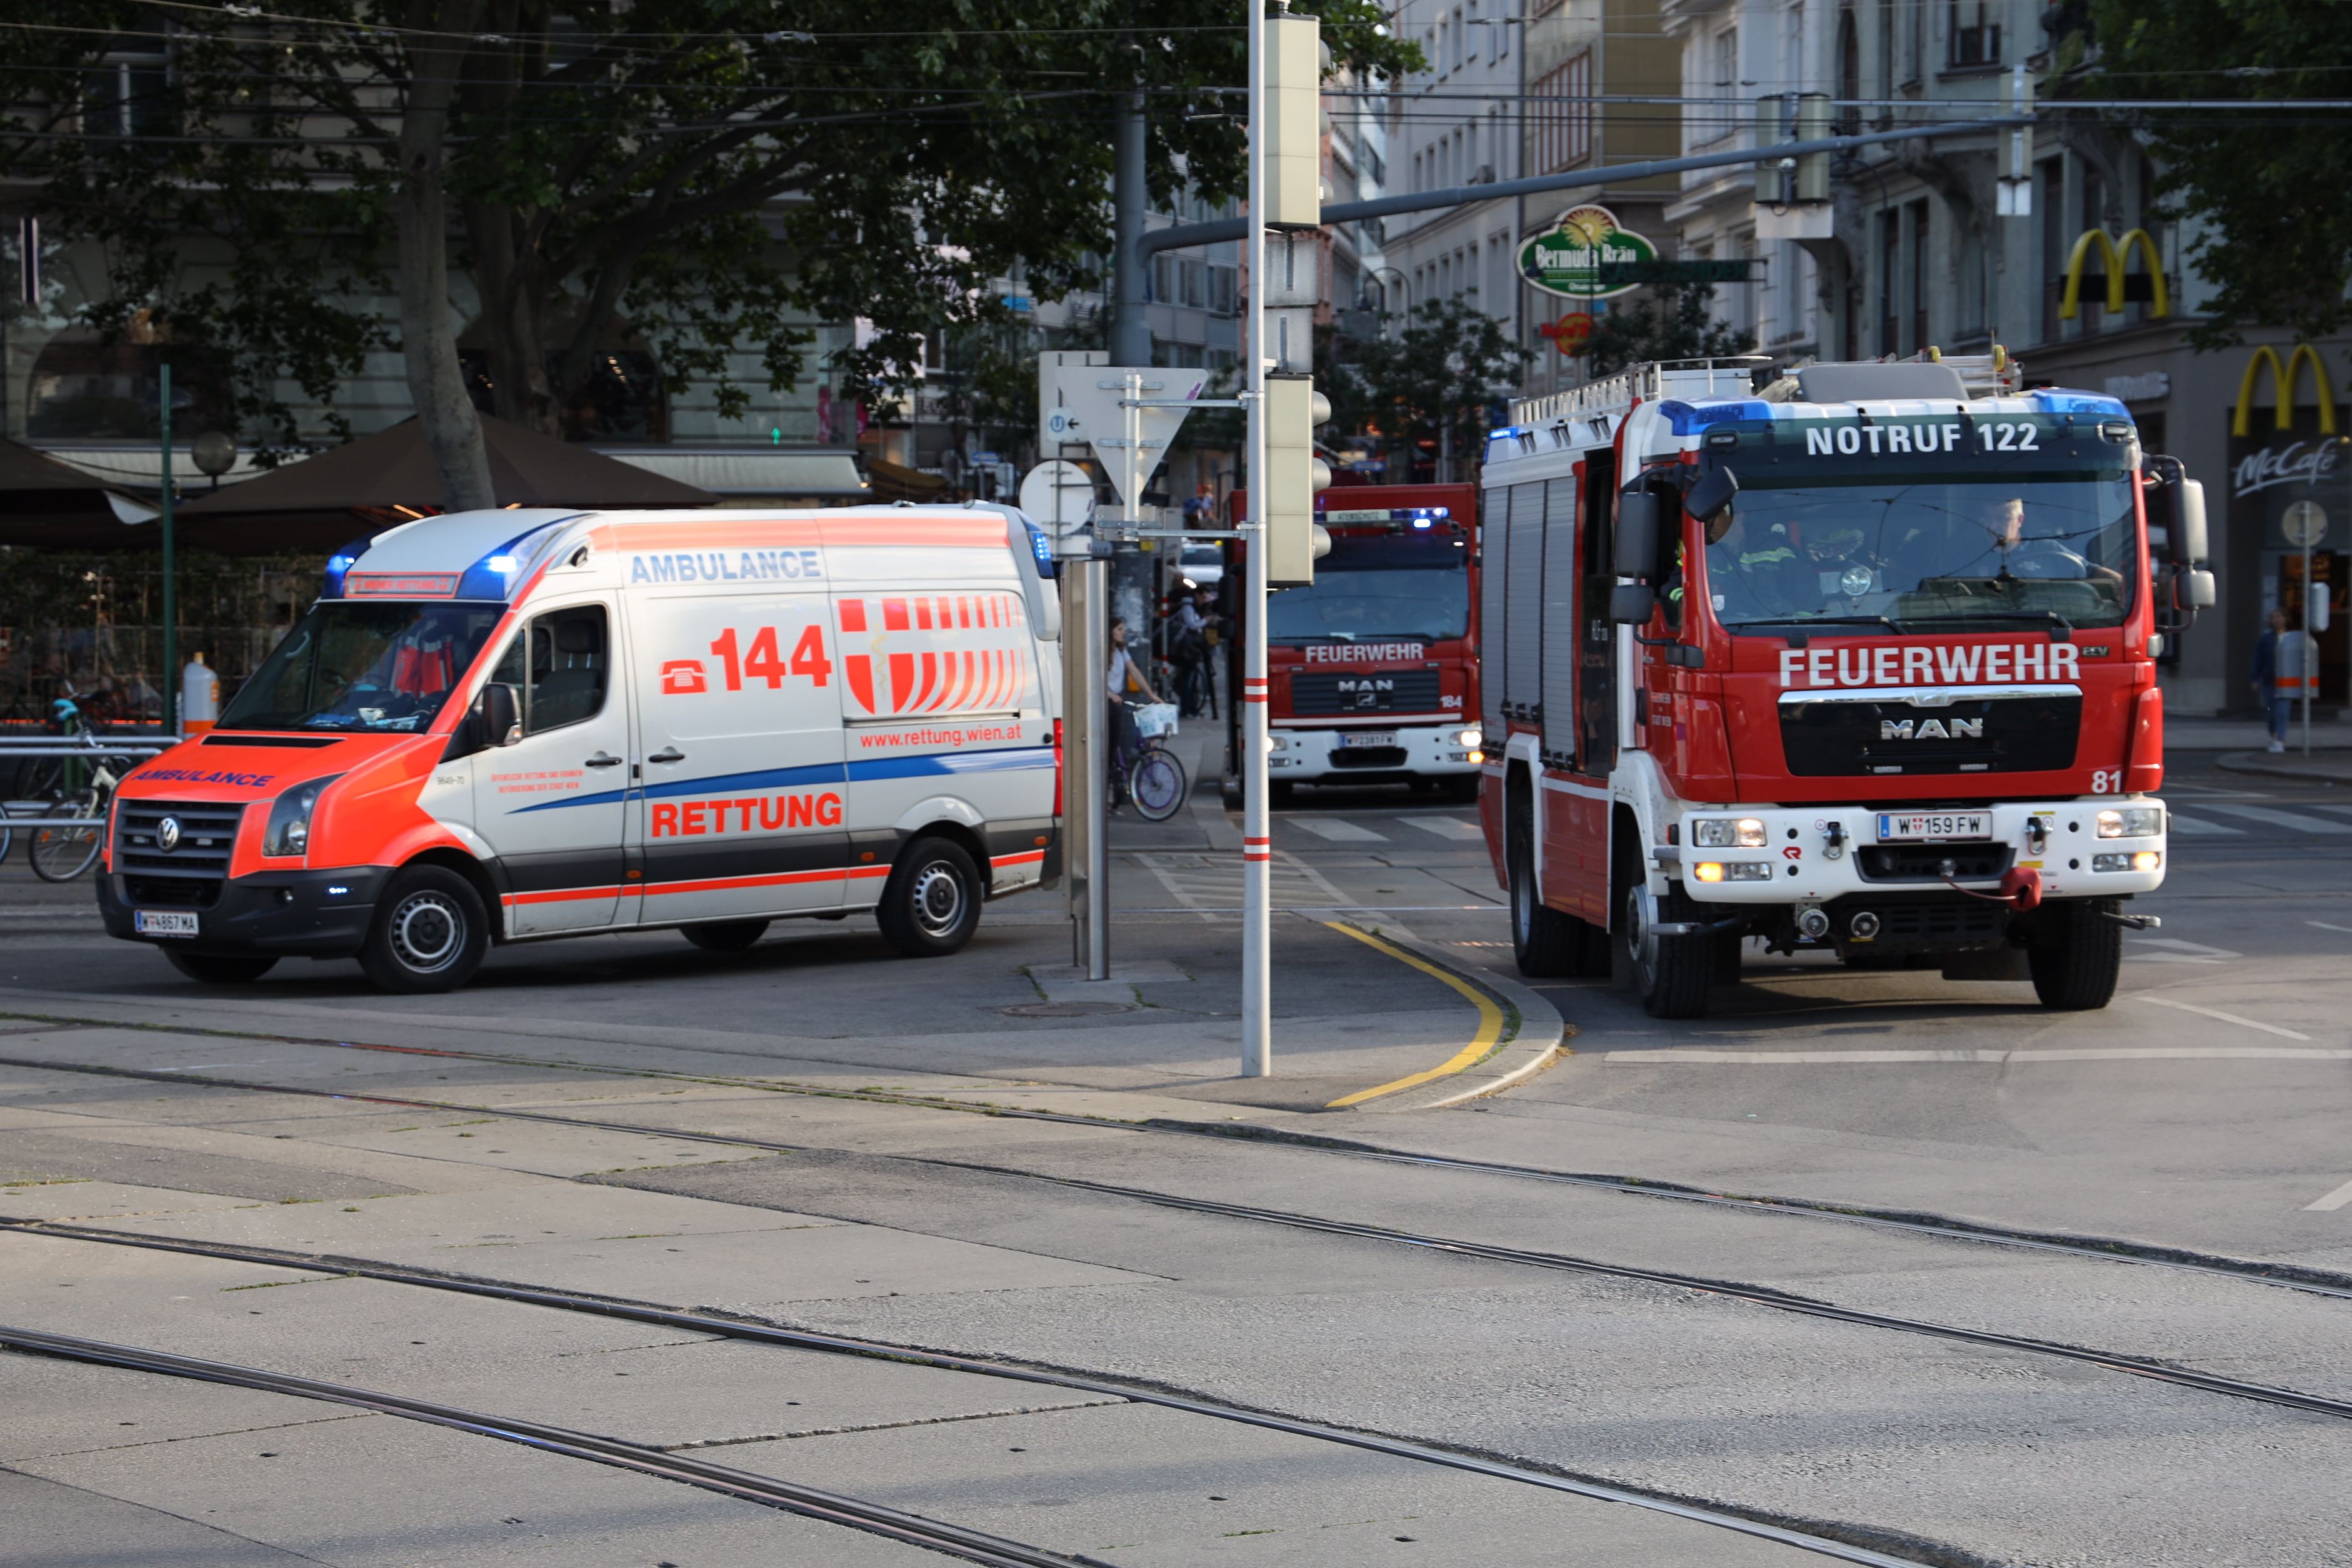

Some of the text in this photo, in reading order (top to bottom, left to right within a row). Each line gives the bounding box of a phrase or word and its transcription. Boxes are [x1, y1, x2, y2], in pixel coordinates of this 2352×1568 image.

[1536, 243, 1636, 269] Bermuda Bräu
[1806, 423, 2039, 455] NOTRUF 122
[2231, 438, 2339, 487] McCafé
[631, 551, 821, 584] AMBULANCE
[710, 625, 832, 691] 144
[1306, 643, 1423, 662] FEUERWEHR
[1779, 642, 2081, 687] FEUERWEHR
[1338, 680, 1393, 692] MAN
[1440, 695, 1463, 708] 184
[859, 723, 1021, 747] www.rettung.wien.at
[1881, 718, 1983, 739] MAN
[132, 770, 275, 787] AMBULANCE
[2092, 771, 2121, 793] 81
[651, 792, 841, 837] RETTUNG
[1899, 818, 1910, 834] W
